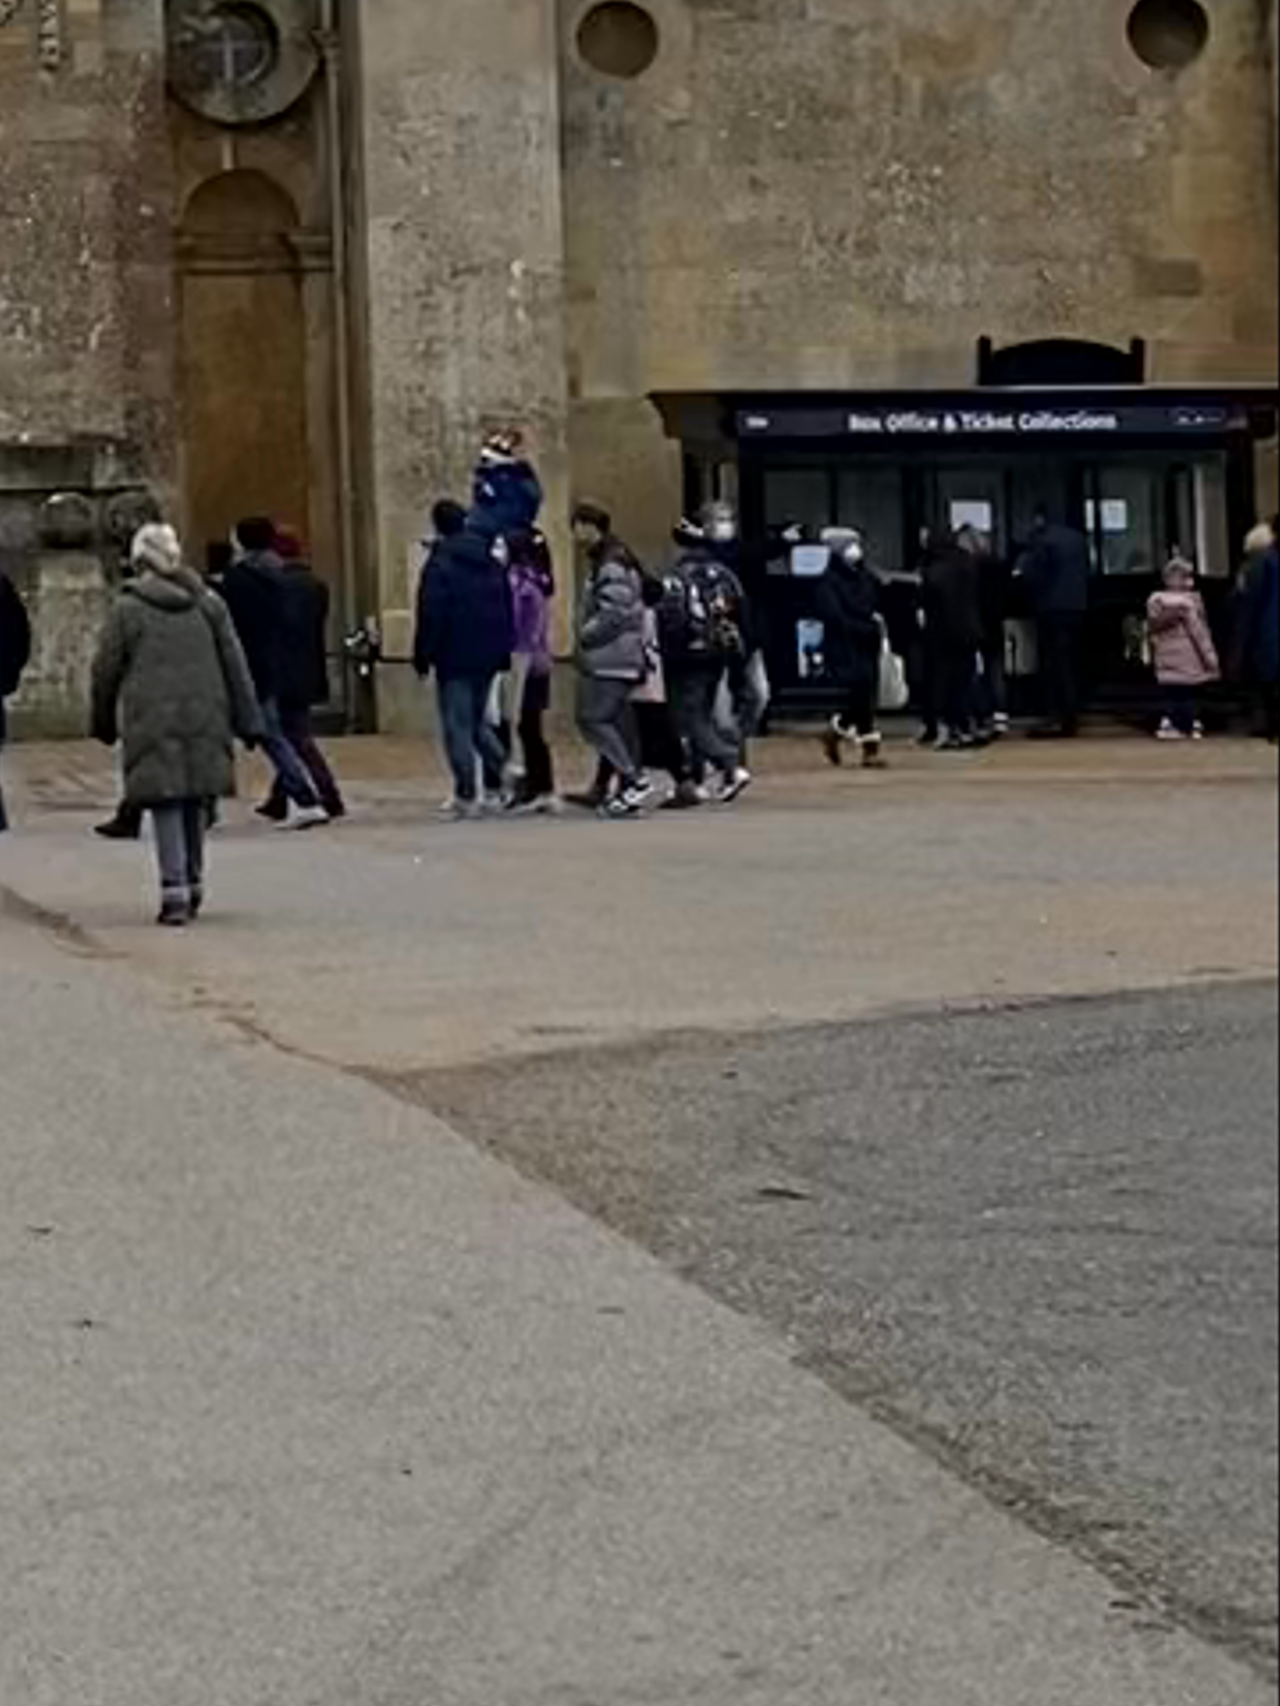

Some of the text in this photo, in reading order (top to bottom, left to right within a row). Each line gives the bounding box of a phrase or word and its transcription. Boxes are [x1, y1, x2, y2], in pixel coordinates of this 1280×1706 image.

[848, 410, 1117, 432] Box Office & Ticket Collections
